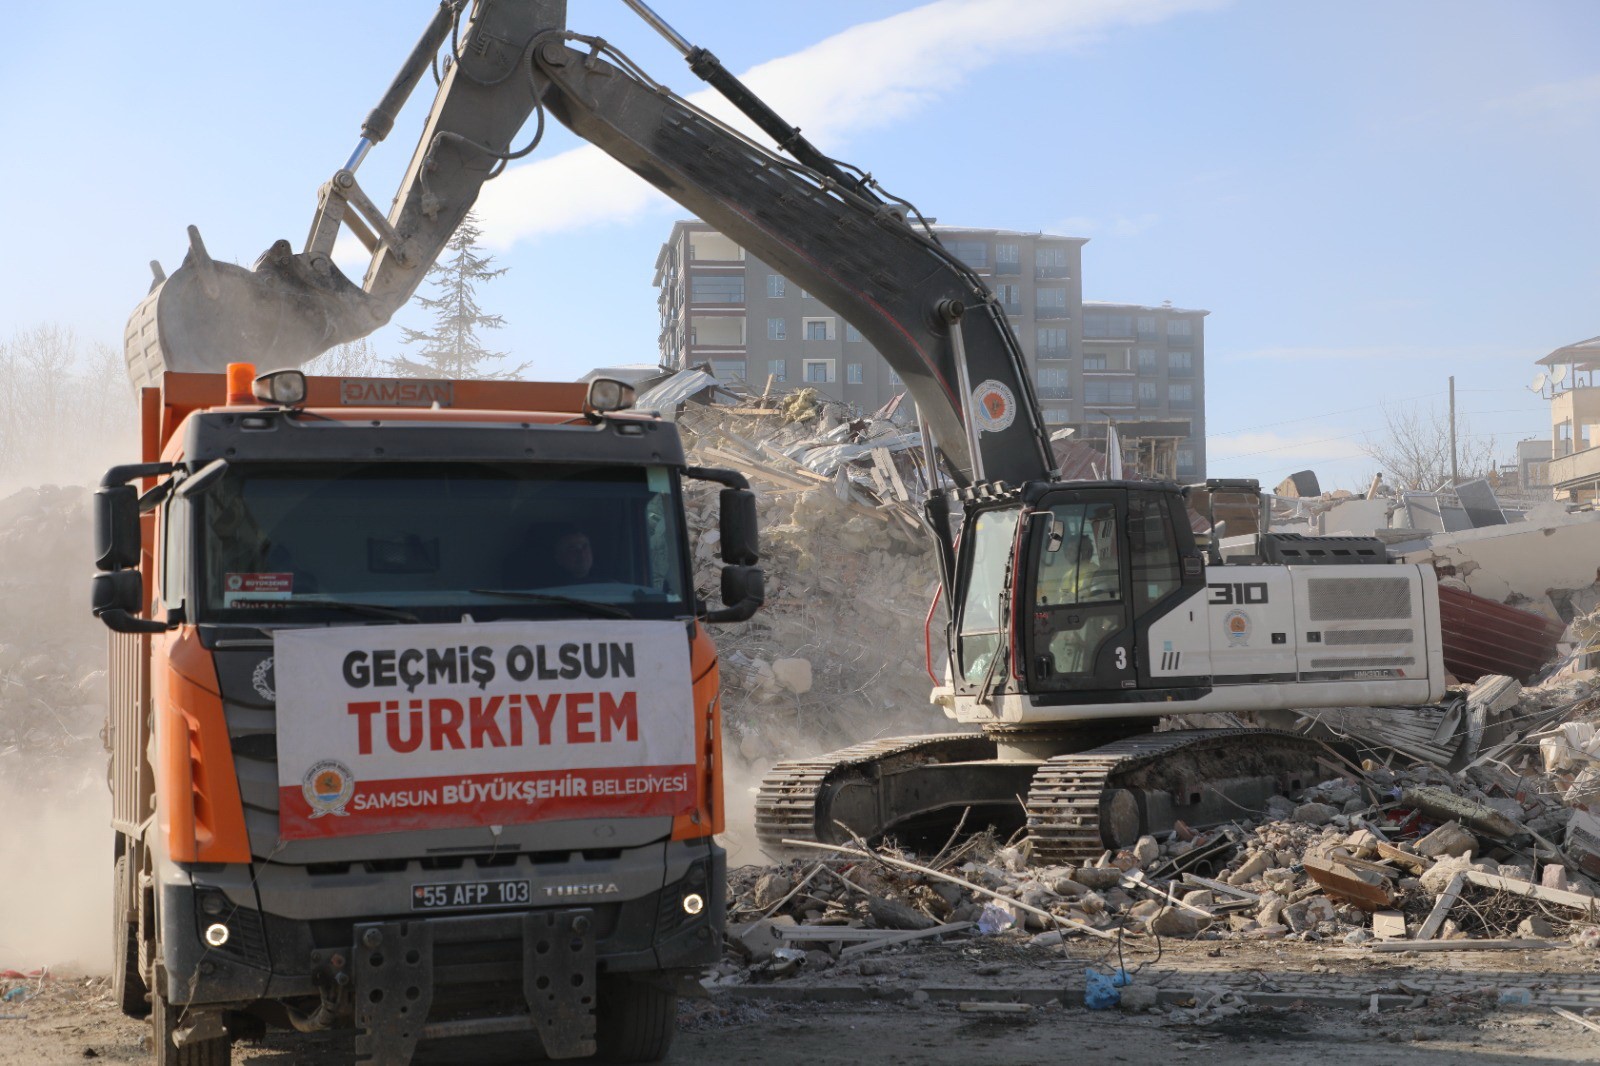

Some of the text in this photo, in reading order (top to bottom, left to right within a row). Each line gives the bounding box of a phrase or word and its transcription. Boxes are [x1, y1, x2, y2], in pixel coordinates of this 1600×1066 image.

[344, 383, 450, 401] DAMSAN
[1208, 582, 1269, 605] 310
[342, 643, 636, 694] GEÇMİŞ OLSUN
[1115, 646, 1127, 670] 3
[347, 691, 639, 755] TÜRKİYEM
[354, 772, 688, 810] SAMSUN BÜYÜKŞEHİR BELEDİYESİ
[424, 882, 530, 906] 55 AFP 103
